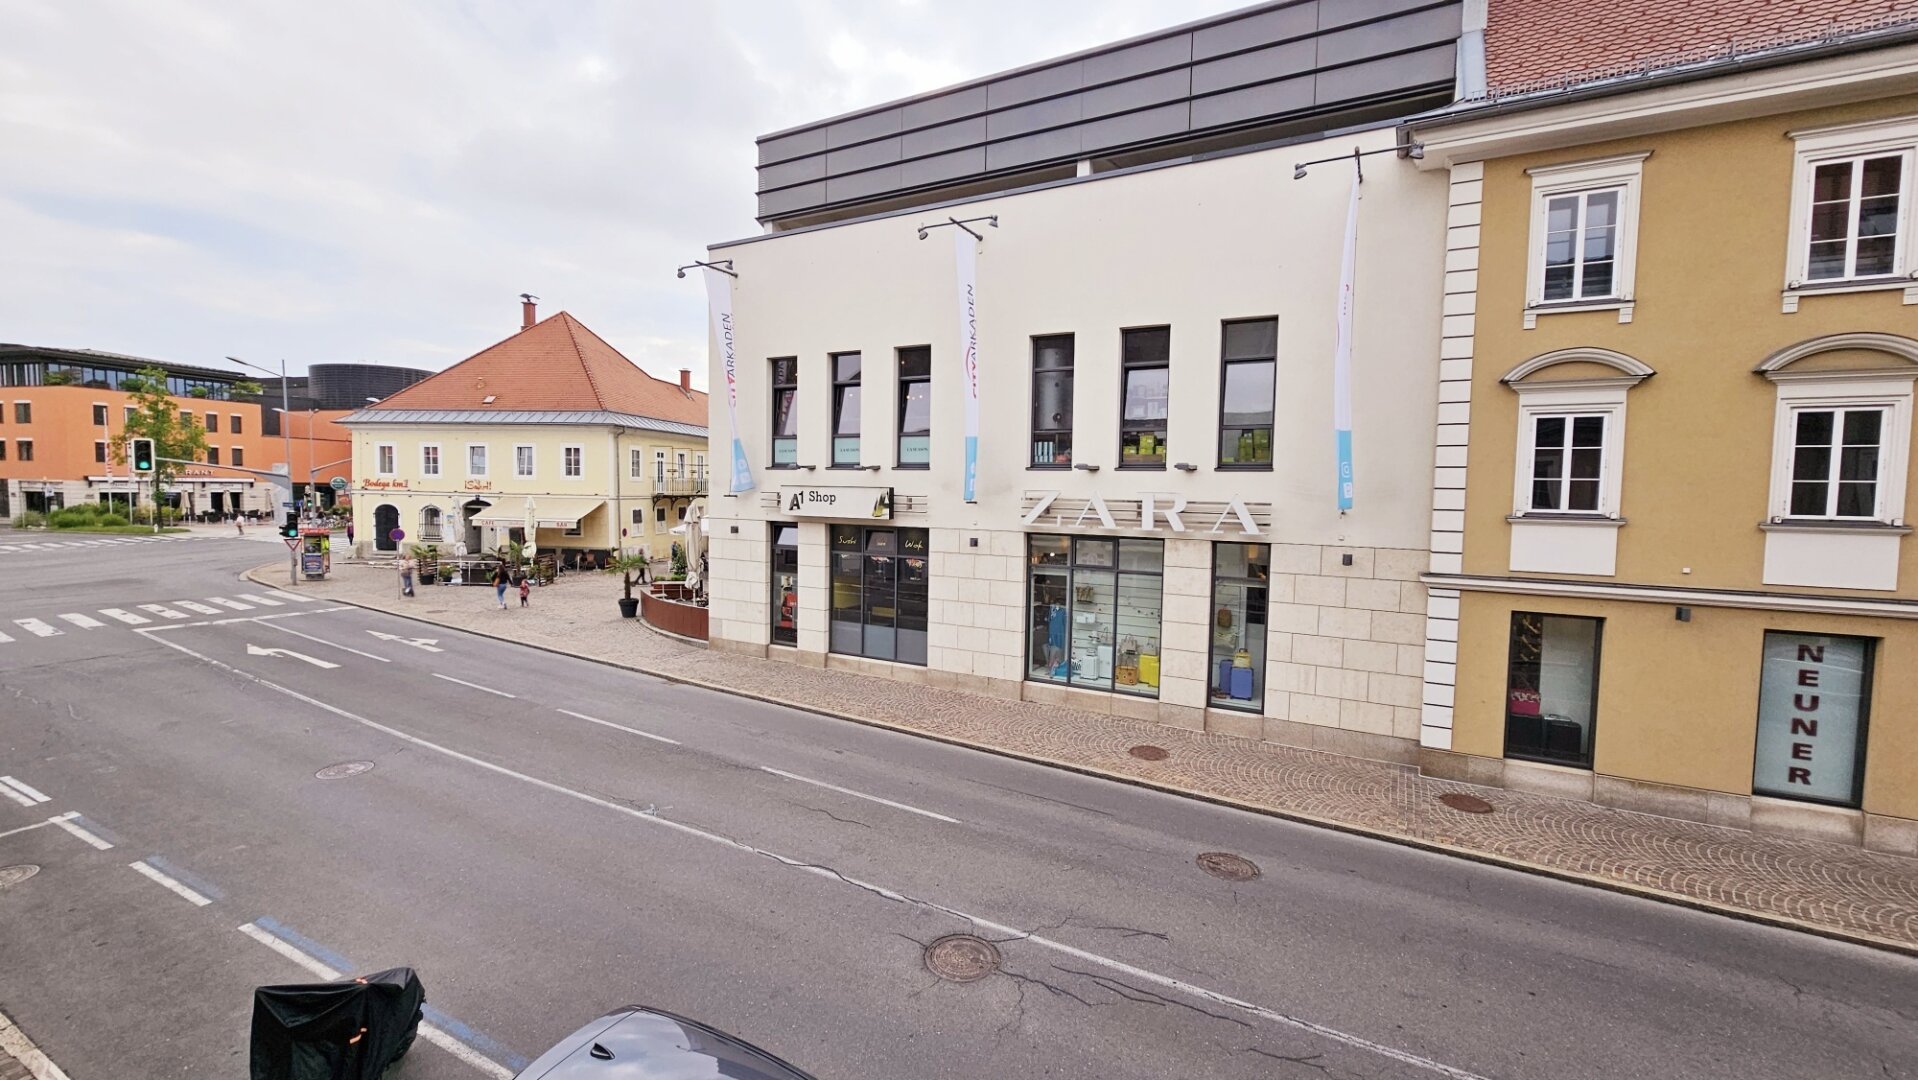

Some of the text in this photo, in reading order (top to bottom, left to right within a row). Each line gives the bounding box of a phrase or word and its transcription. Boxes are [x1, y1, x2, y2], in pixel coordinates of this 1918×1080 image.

[363, 478, 390, 490] Bodega
[788, 490, 836, 511] A1 Shop
[1021, 489, 1269, 536] ZARA
[904, 539, 924, 551] Wok
[1788, 644, 1825, 786] NEUNER
